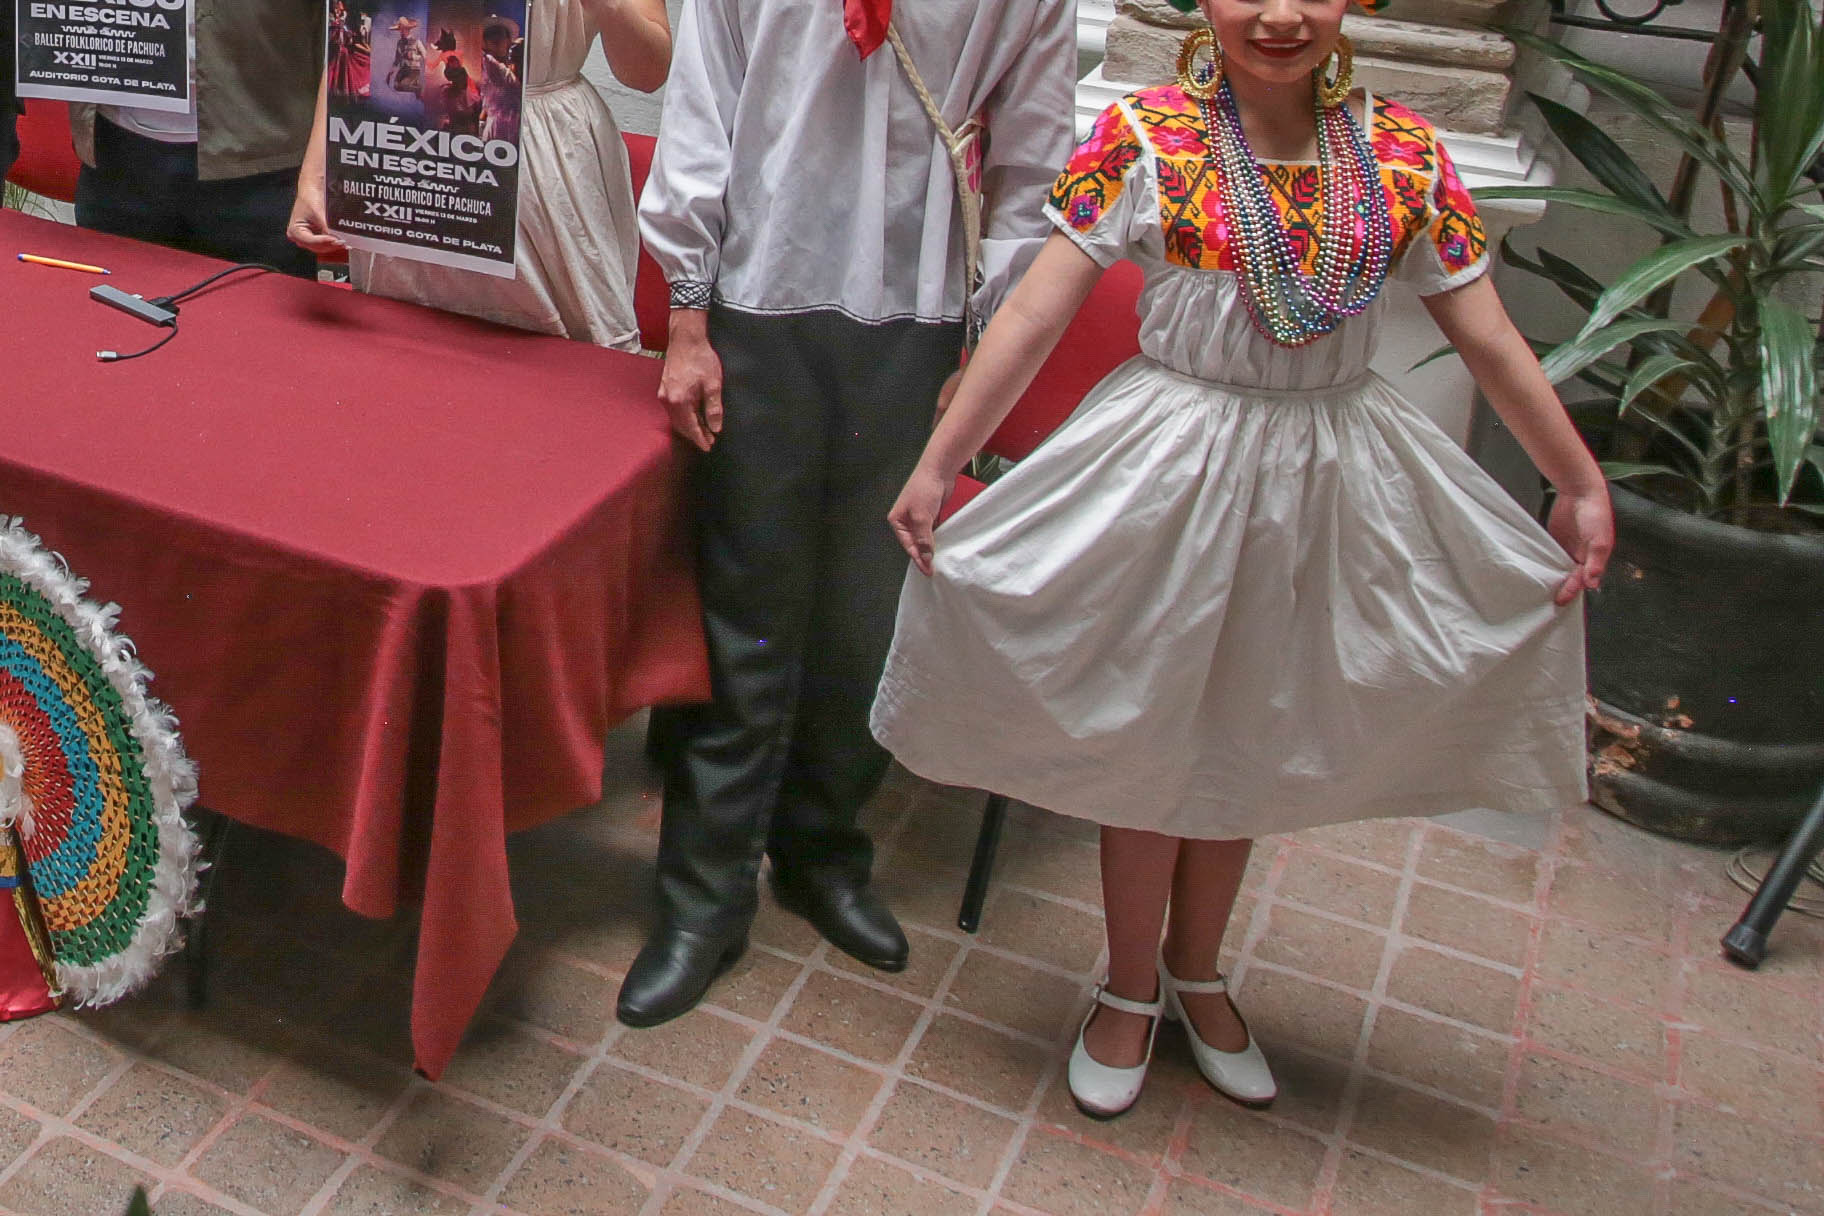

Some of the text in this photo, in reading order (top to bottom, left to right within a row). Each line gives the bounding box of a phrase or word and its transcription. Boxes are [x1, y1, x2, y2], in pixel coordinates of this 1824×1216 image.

[30, 3, 171, 30] EN ESCENA
[34, 32, 166, 58] BALLET FOLKLORICO DE PACHUCA
[53, 50, 97, 67] XXII
[29, 70, 176, 91] AUDITORIO GOTA DE PLATA
[329, 116, 518, 167] MÉXICO
[340, 148, 500, 187] EN ESCENA
[343, 180, 492, 217] BALLET FOLKLORICO DE PACHUCA
[363, 200, 413, 221] XXII
[338, 218, 402, 236] AUDITORIO
[406, 229, 440, 243] GOTA
[442, 235, 460, 246] DE
[462, 239, 503, 254] PLATA
